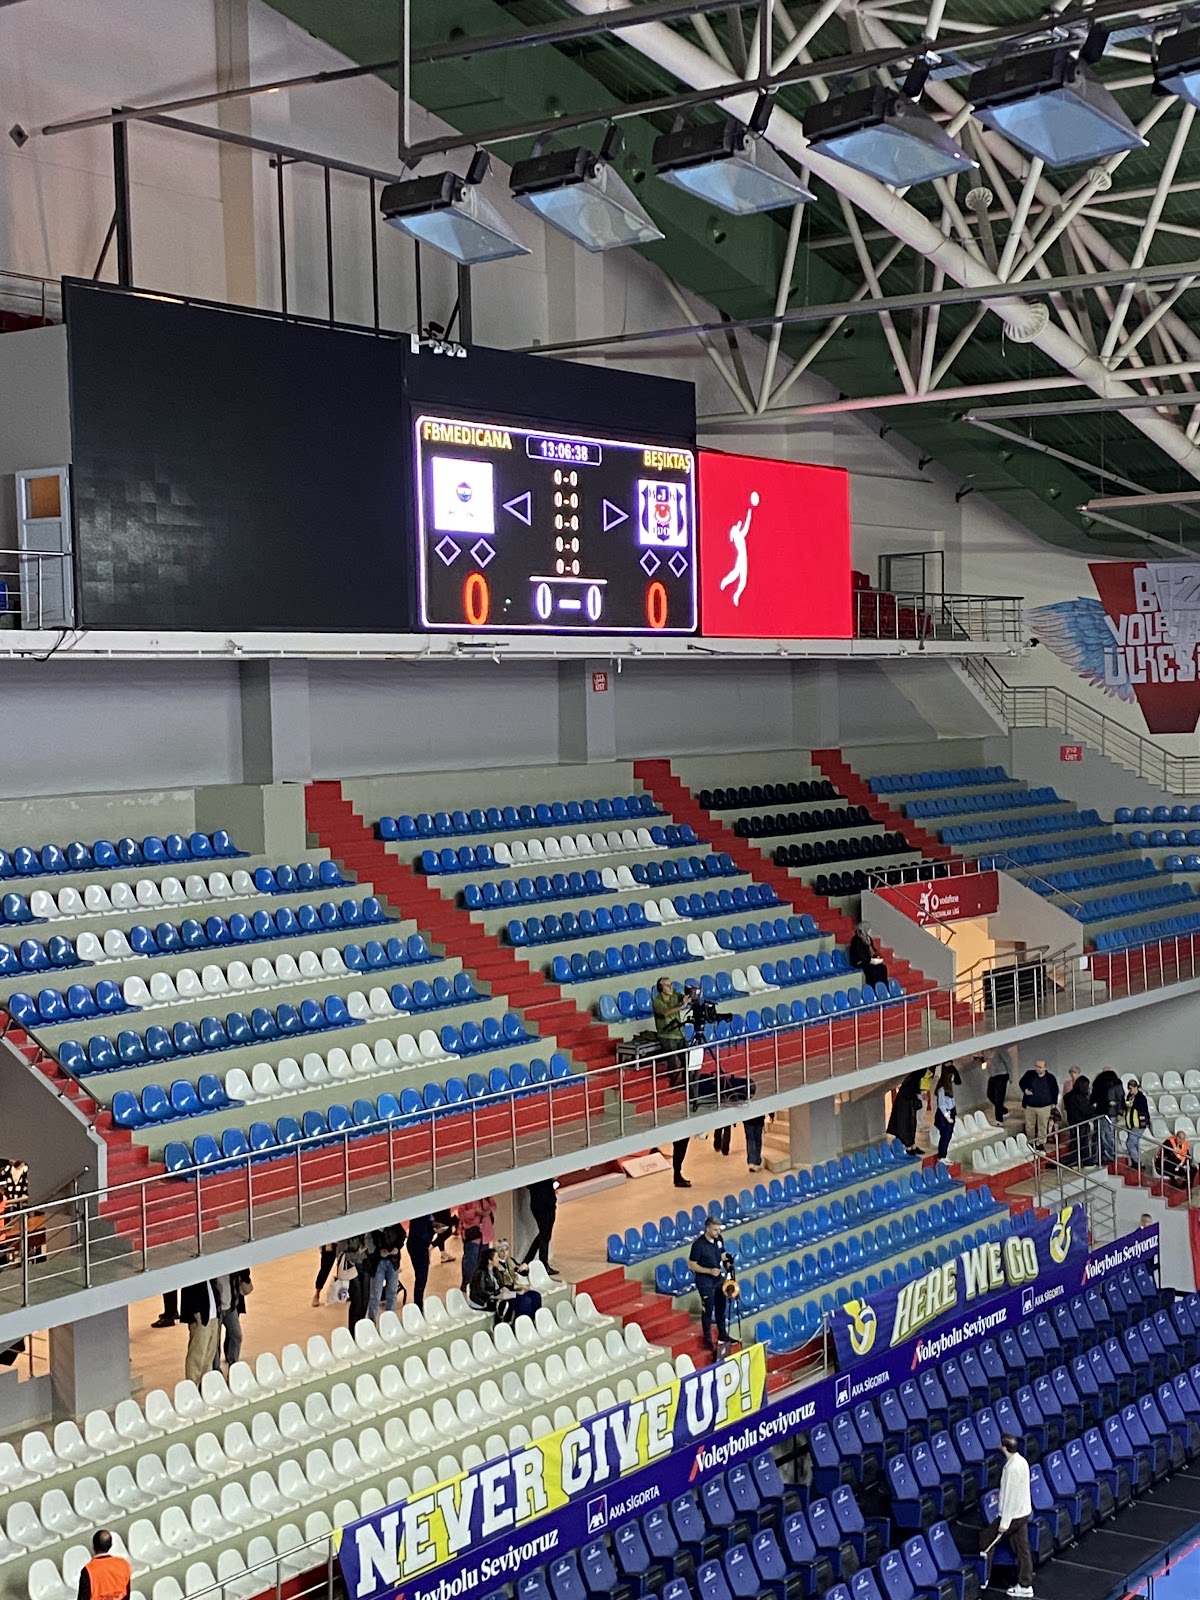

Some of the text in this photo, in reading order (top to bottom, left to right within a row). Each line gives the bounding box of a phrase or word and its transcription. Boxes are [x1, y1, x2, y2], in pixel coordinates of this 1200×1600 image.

[424, 422, 512, 449] FBMEDICANA
[541, 440, 588, 461] 13:06:38
[464, 572, 489, 625] 0
[647, 581, 667, 628] 0
[1083, 1235, 1159, 1282] Voleybolu Seviyoruz
[890, 1236, 1039, 1348] HERE WE GO
[913, 1307, 1007, 1366] Voleybolu Seviyoruz
[851, 1371, 890, 1398] AXA SİGORTA
[691, 1401, 816, 1477] Voleybolu Seviyoruz
[355, 1350, 751, 1598] NEVER GIVE UP!
[609, 1485, 660, 1520] AXA SİGORTA
[481, 1529, 559, 1582] Seviyoruz
